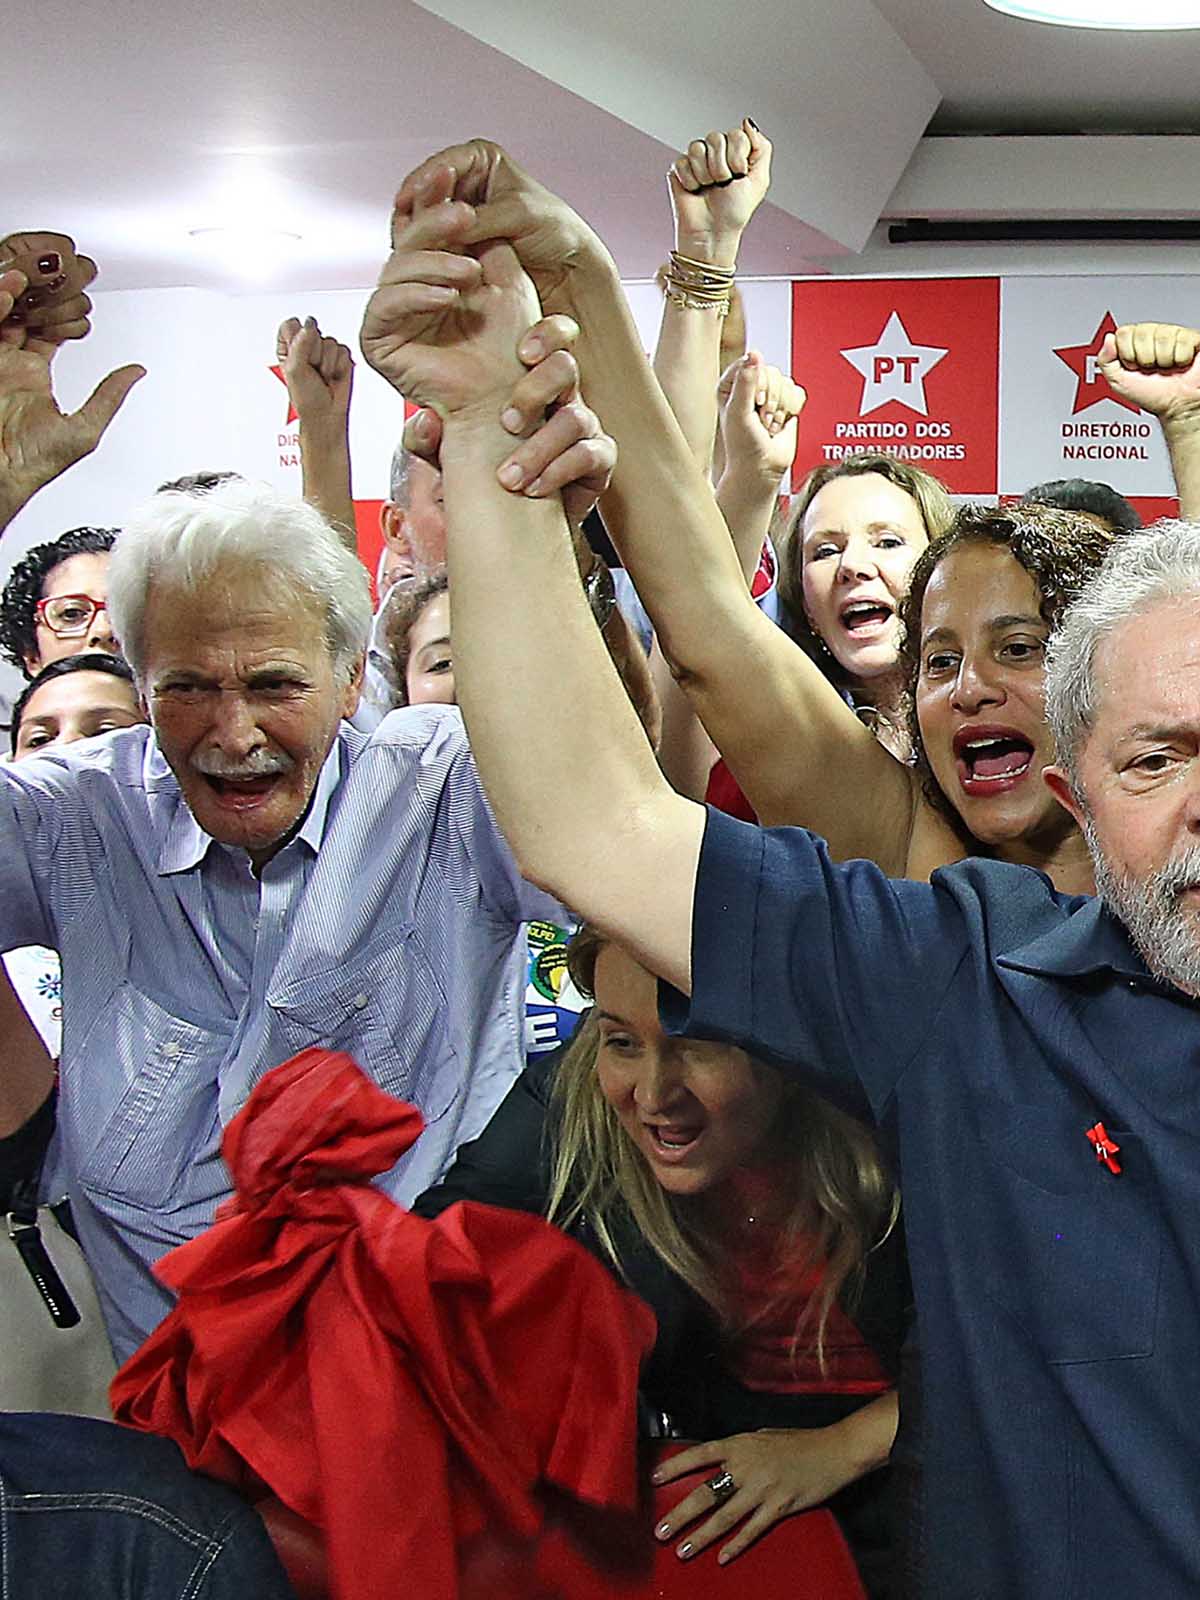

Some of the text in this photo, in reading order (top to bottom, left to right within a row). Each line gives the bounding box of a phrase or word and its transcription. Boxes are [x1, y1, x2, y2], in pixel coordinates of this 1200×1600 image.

[873, 356, 920, 384] PT
[1085, 355, 1101, 384] P
[835, 422, 951, 438] PARTIDO DOS
[1062, 421, 1151, 438] DIRETÓRIO
[1063, 446, 1149, 459] NACIONAL
[526, 1013, 562, 1053] E
